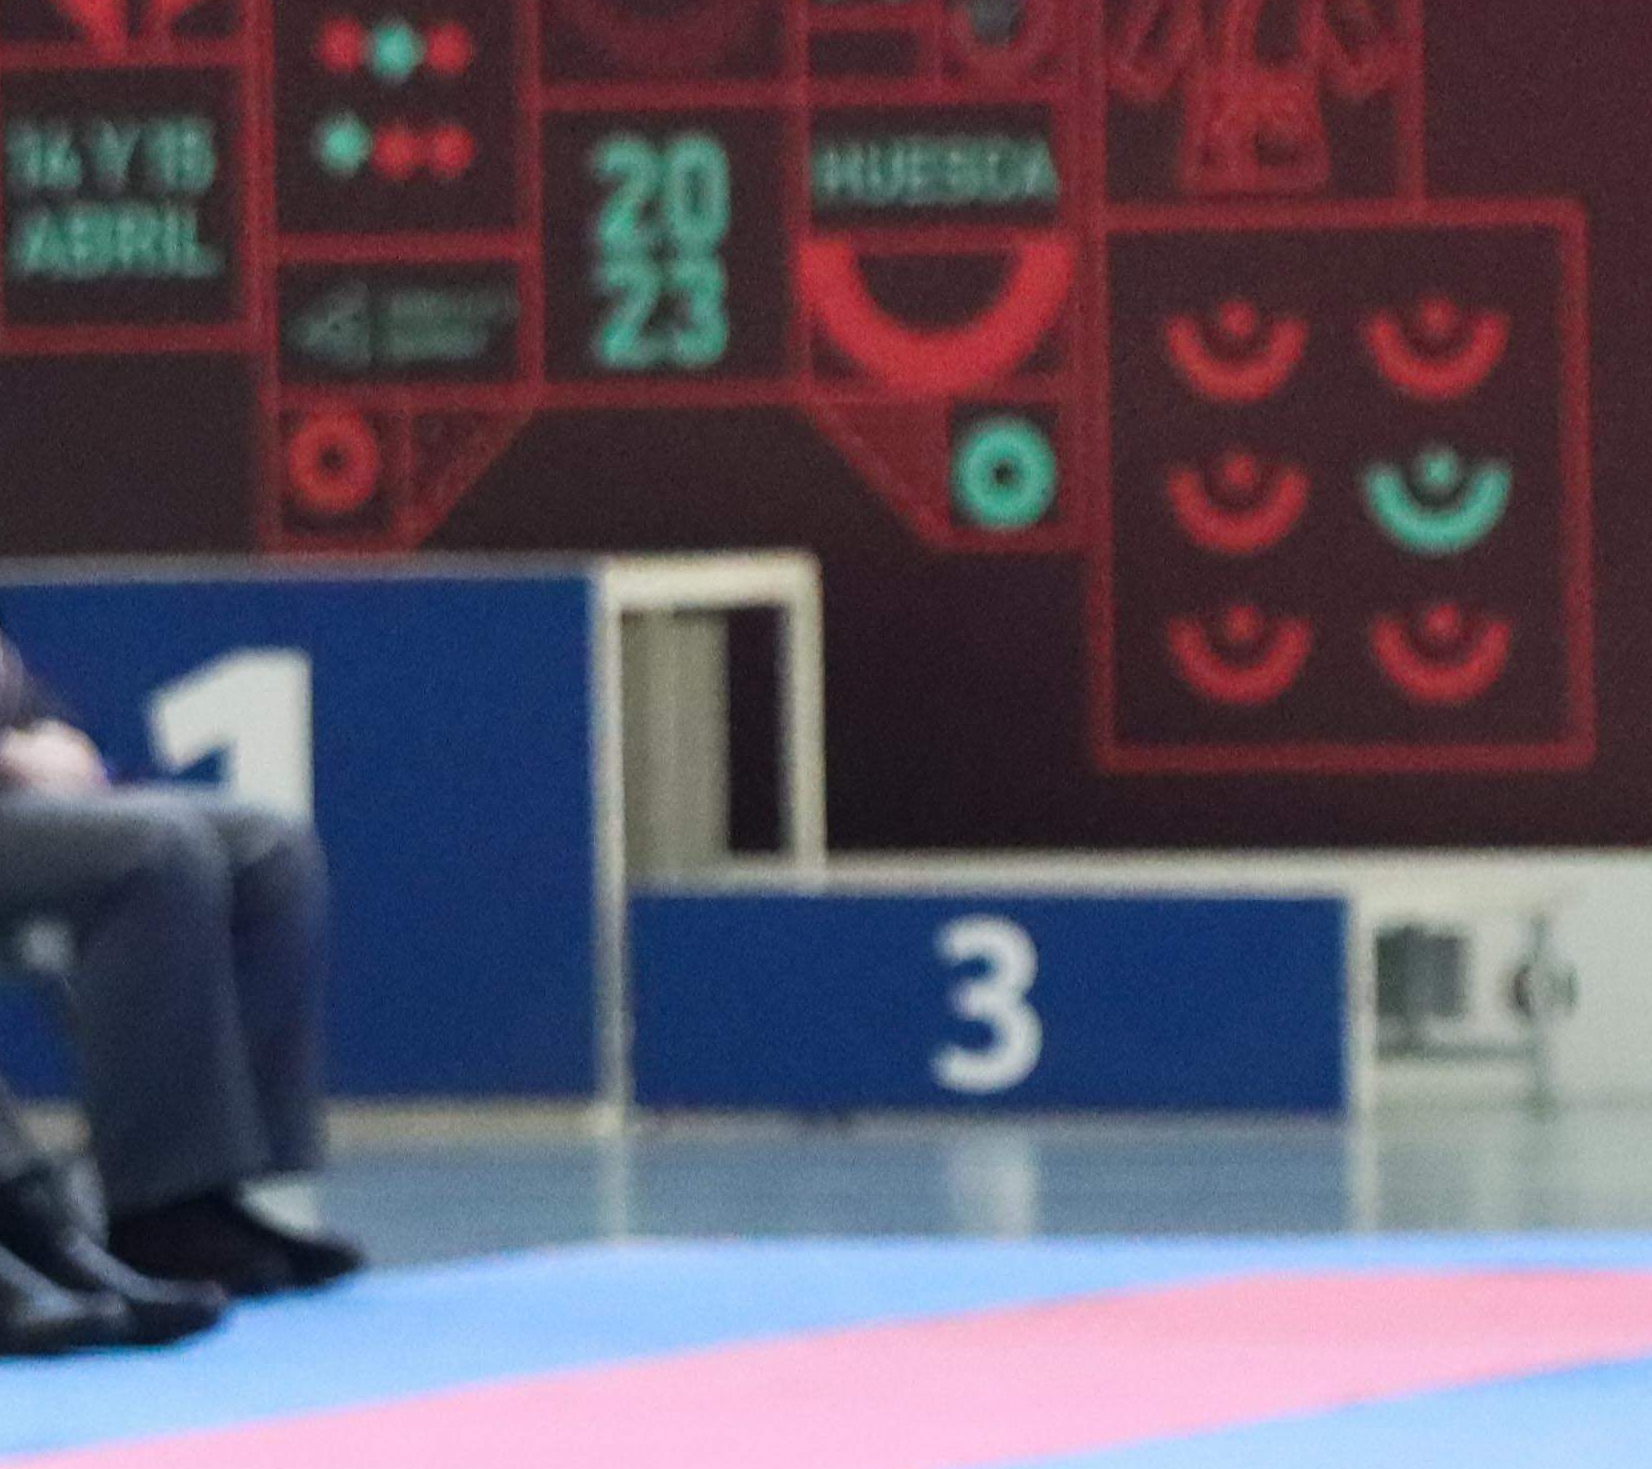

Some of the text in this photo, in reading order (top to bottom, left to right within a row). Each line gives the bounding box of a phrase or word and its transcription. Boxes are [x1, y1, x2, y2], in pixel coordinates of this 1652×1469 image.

[594, 134, 730, 240] 20
[812, 135, 1060, 205] HUESCA
[595, 252, 728, 368] 23
[150, 646, 316, 827] 1
[932, 913, 1043, 1094] 3
